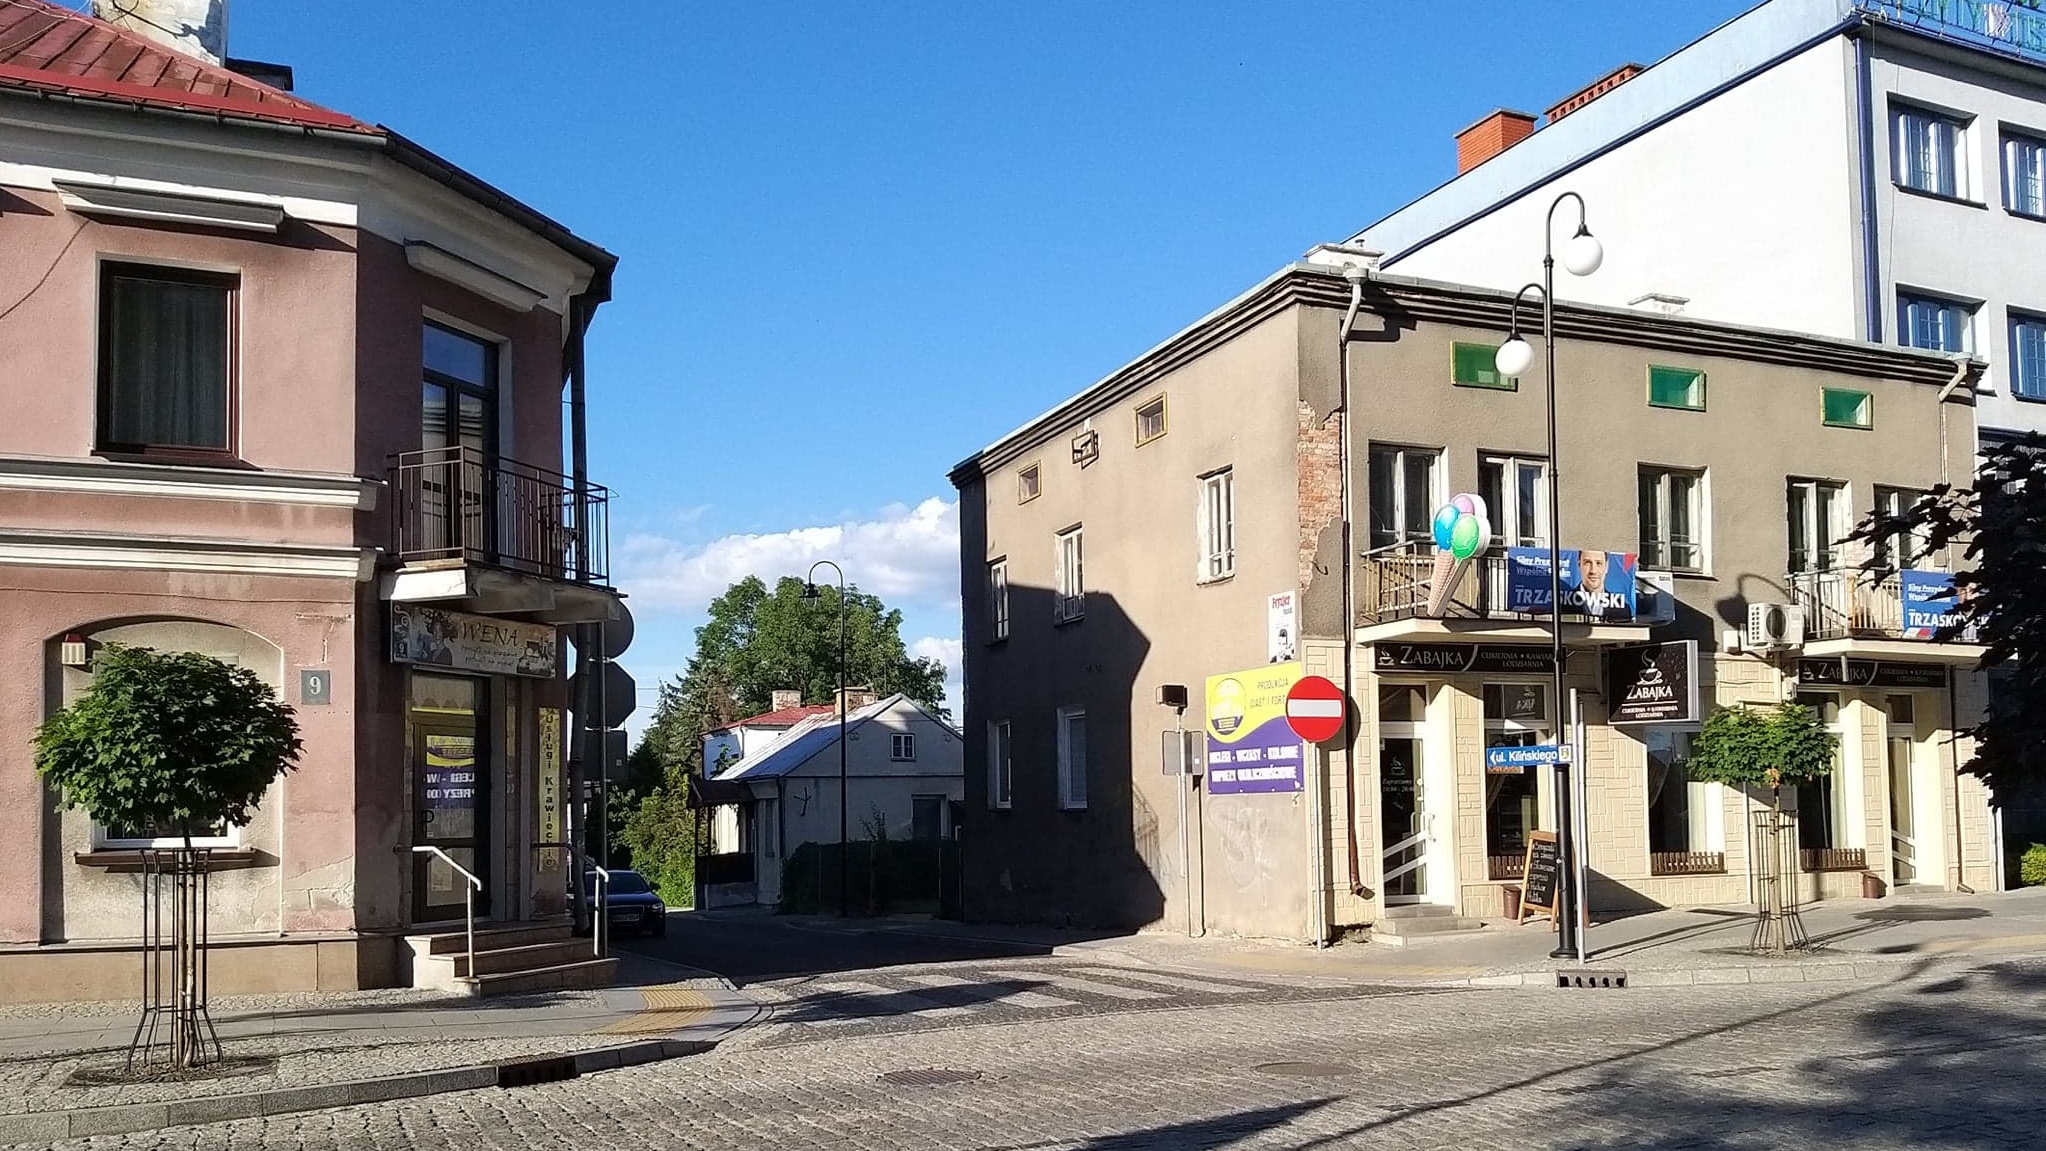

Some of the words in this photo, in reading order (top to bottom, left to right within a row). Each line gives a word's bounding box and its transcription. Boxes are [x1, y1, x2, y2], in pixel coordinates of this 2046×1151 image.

[462, 621, 519, 648] WENA
[309, 676, 322, 695] 9
[1495, 751, 1506, 763] ul.
[1508, 749, 1558, 762] Kilińskiego
